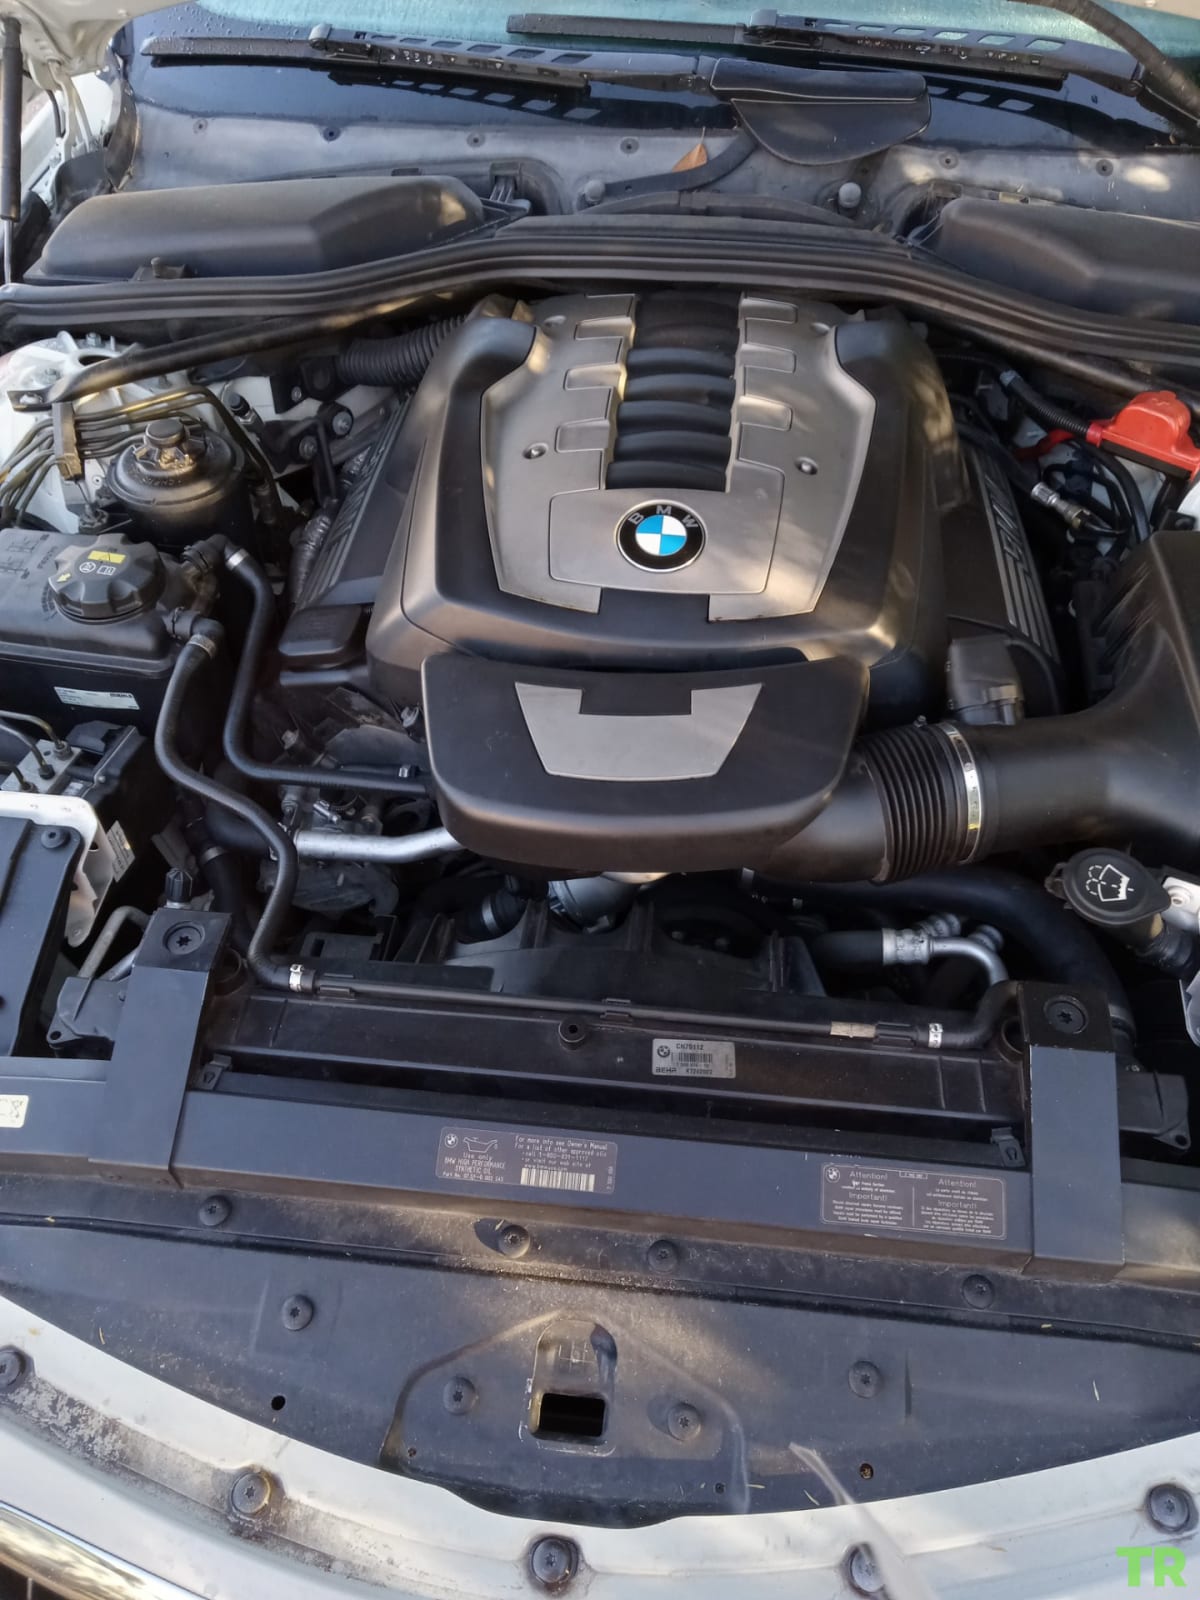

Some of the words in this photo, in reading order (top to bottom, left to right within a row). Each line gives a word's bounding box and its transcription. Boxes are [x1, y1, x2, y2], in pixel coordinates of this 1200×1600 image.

[628, 505, 698, 528] BMW
[590, 1142, 608, 1150] Manual
[849, 1171, 888, 1180] Attention!
[938, 1178, 977, 1188] Attention!
[848, 1192, 888, 1201] Important!
[938, 1199, 977, 1209] Important!
